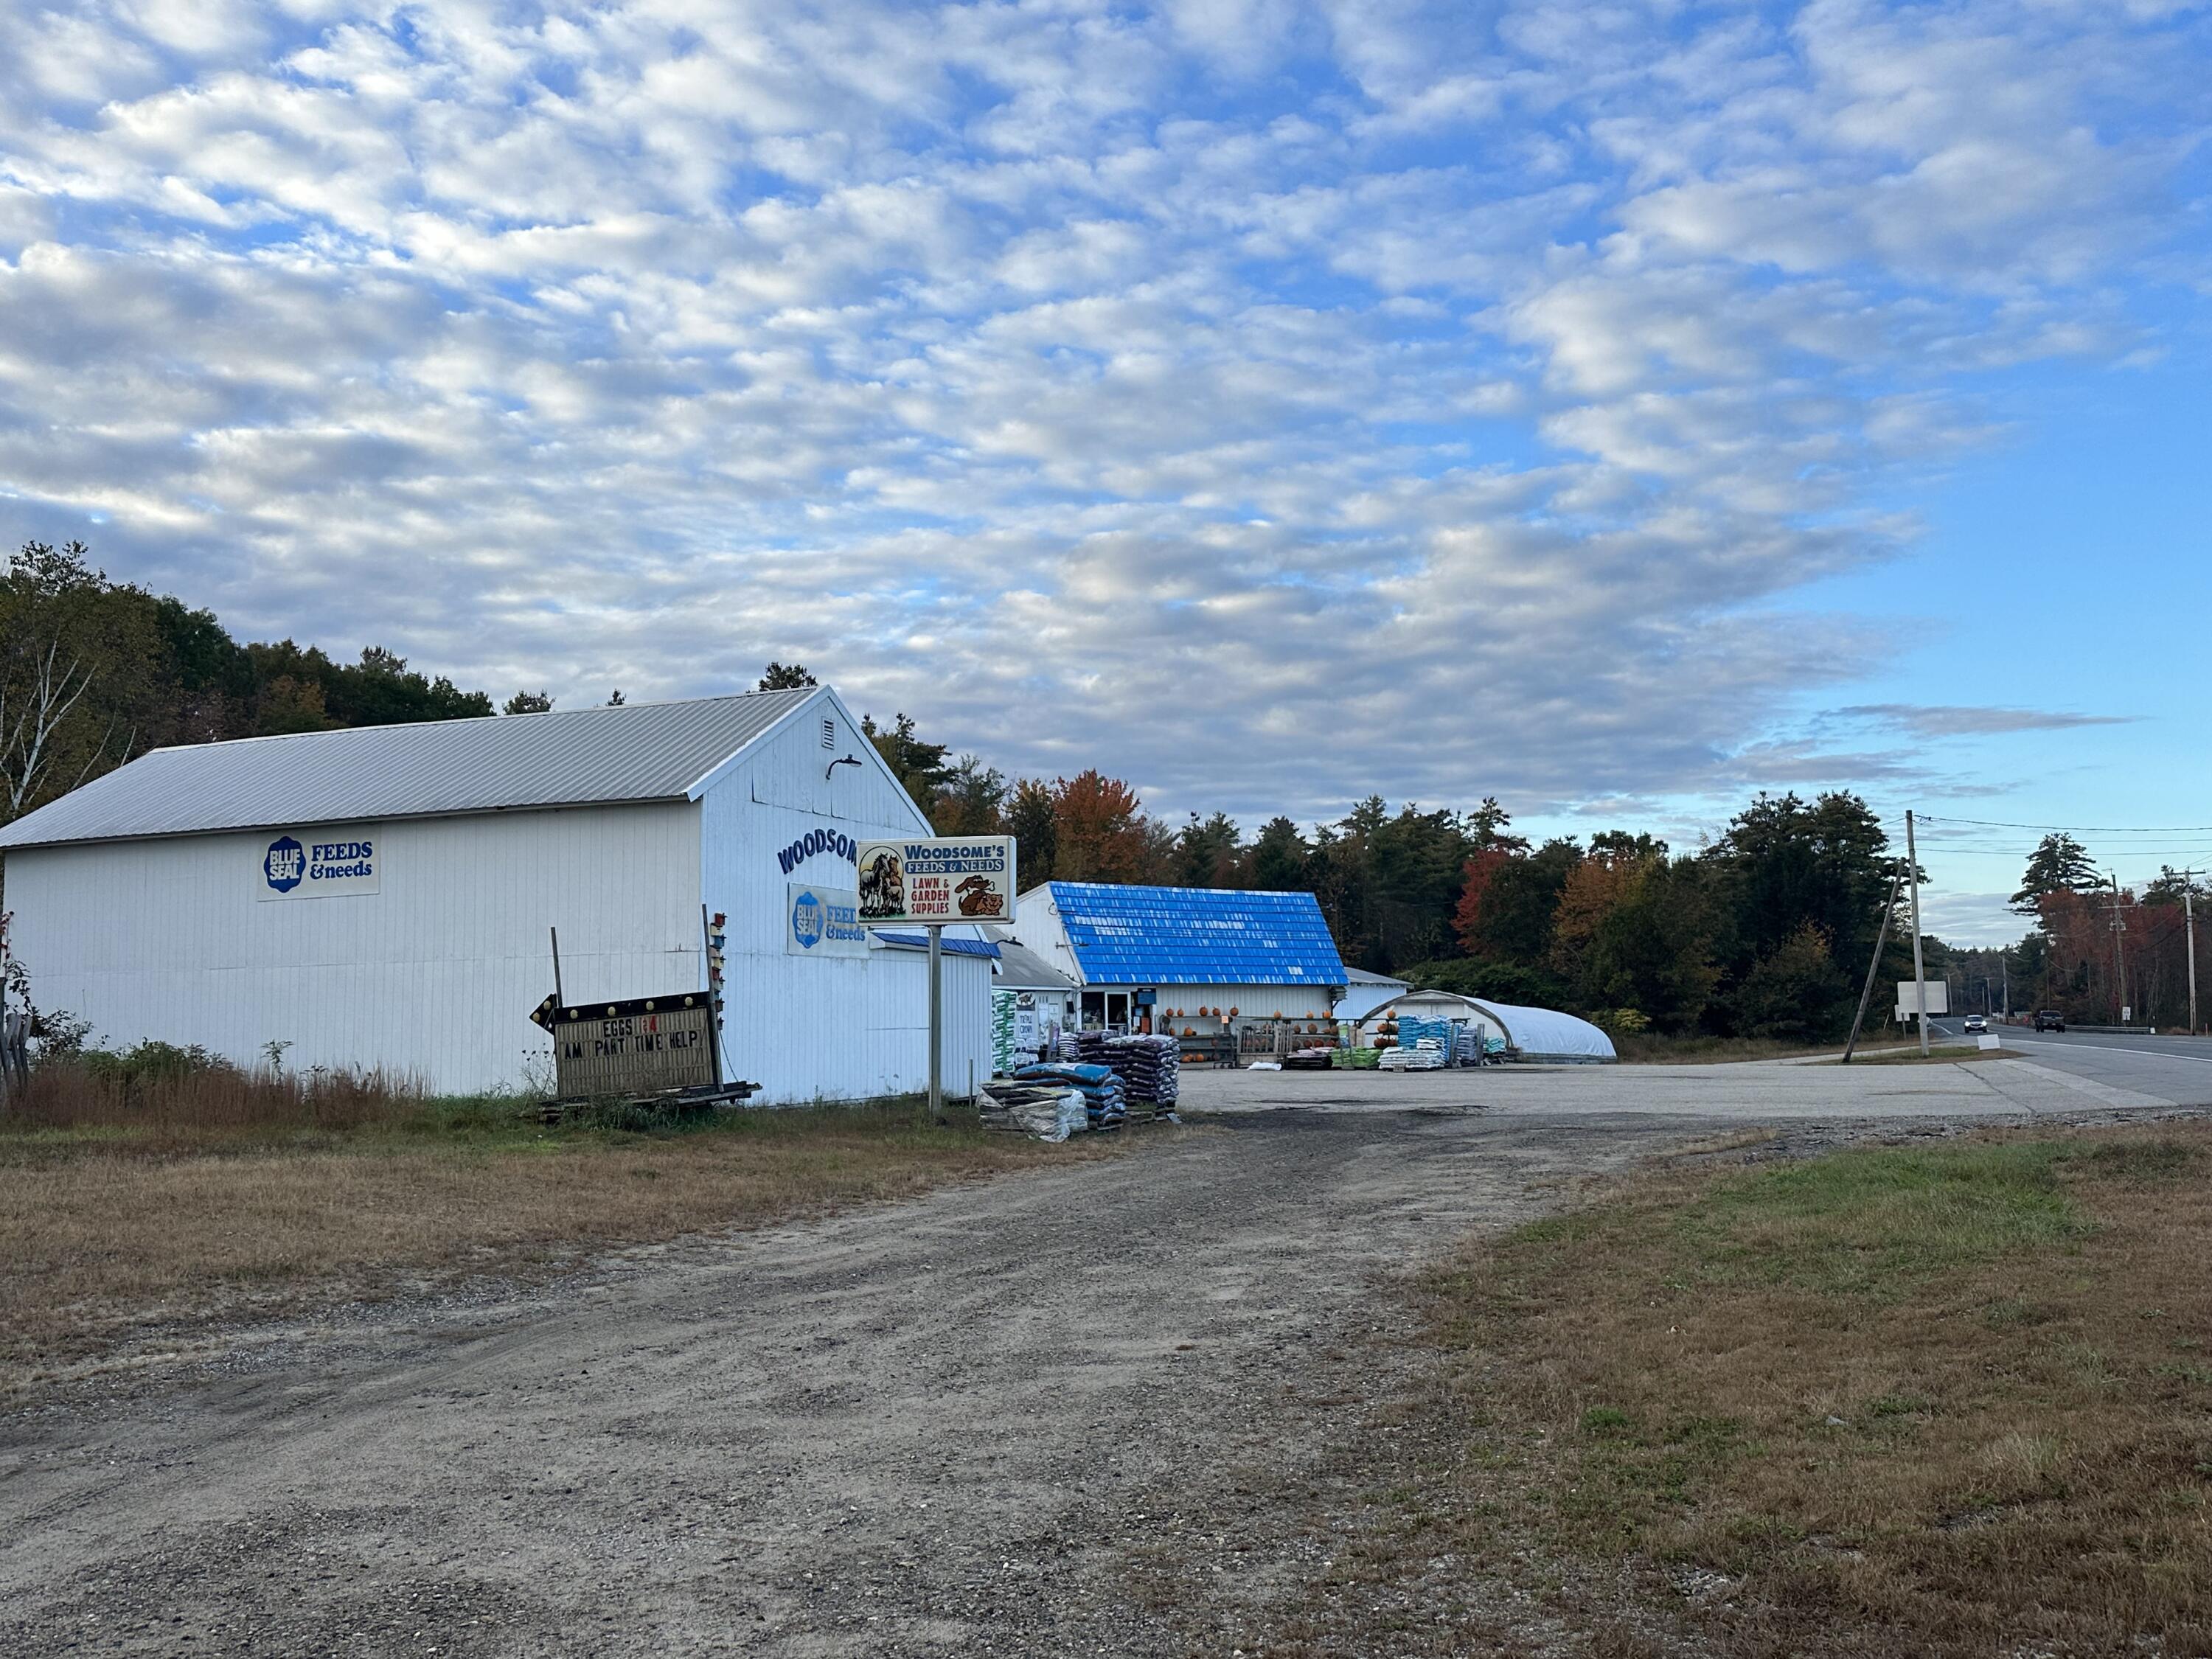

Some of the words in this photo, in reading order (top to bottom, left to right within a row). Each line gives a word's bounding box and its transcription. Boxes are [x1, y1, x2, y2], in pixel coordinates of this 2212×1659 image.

[270, 849, 301, 866] BLUE
[311, 841, 372, 861] FEEDS
[269, 863, 299, 880] SEAL
[310, 860, 372, 880] &needs
[907, 861, 946, 873] FEEDS
[949, 862, 958, 872] &
[961, 859, 1002, 872] NEEDS
[913, 877, 939, 889] LAWN
[943, 879, 950, 888] &
[911, 890, 950, 901] GARDEN
[911, 902, 949, 914] SUPPLIES
[796, 919, 819, 936] SEAL
[826, 924, 866, 941] &needs
[602, 1018, 633, 1037] EGGS
[565, 1042, 582, 1060] AM
[595, 1037, 625, 1057] PART
[635, 1033, 663, 1052] TIME
[669, 1030, 698, 1049] HELP
